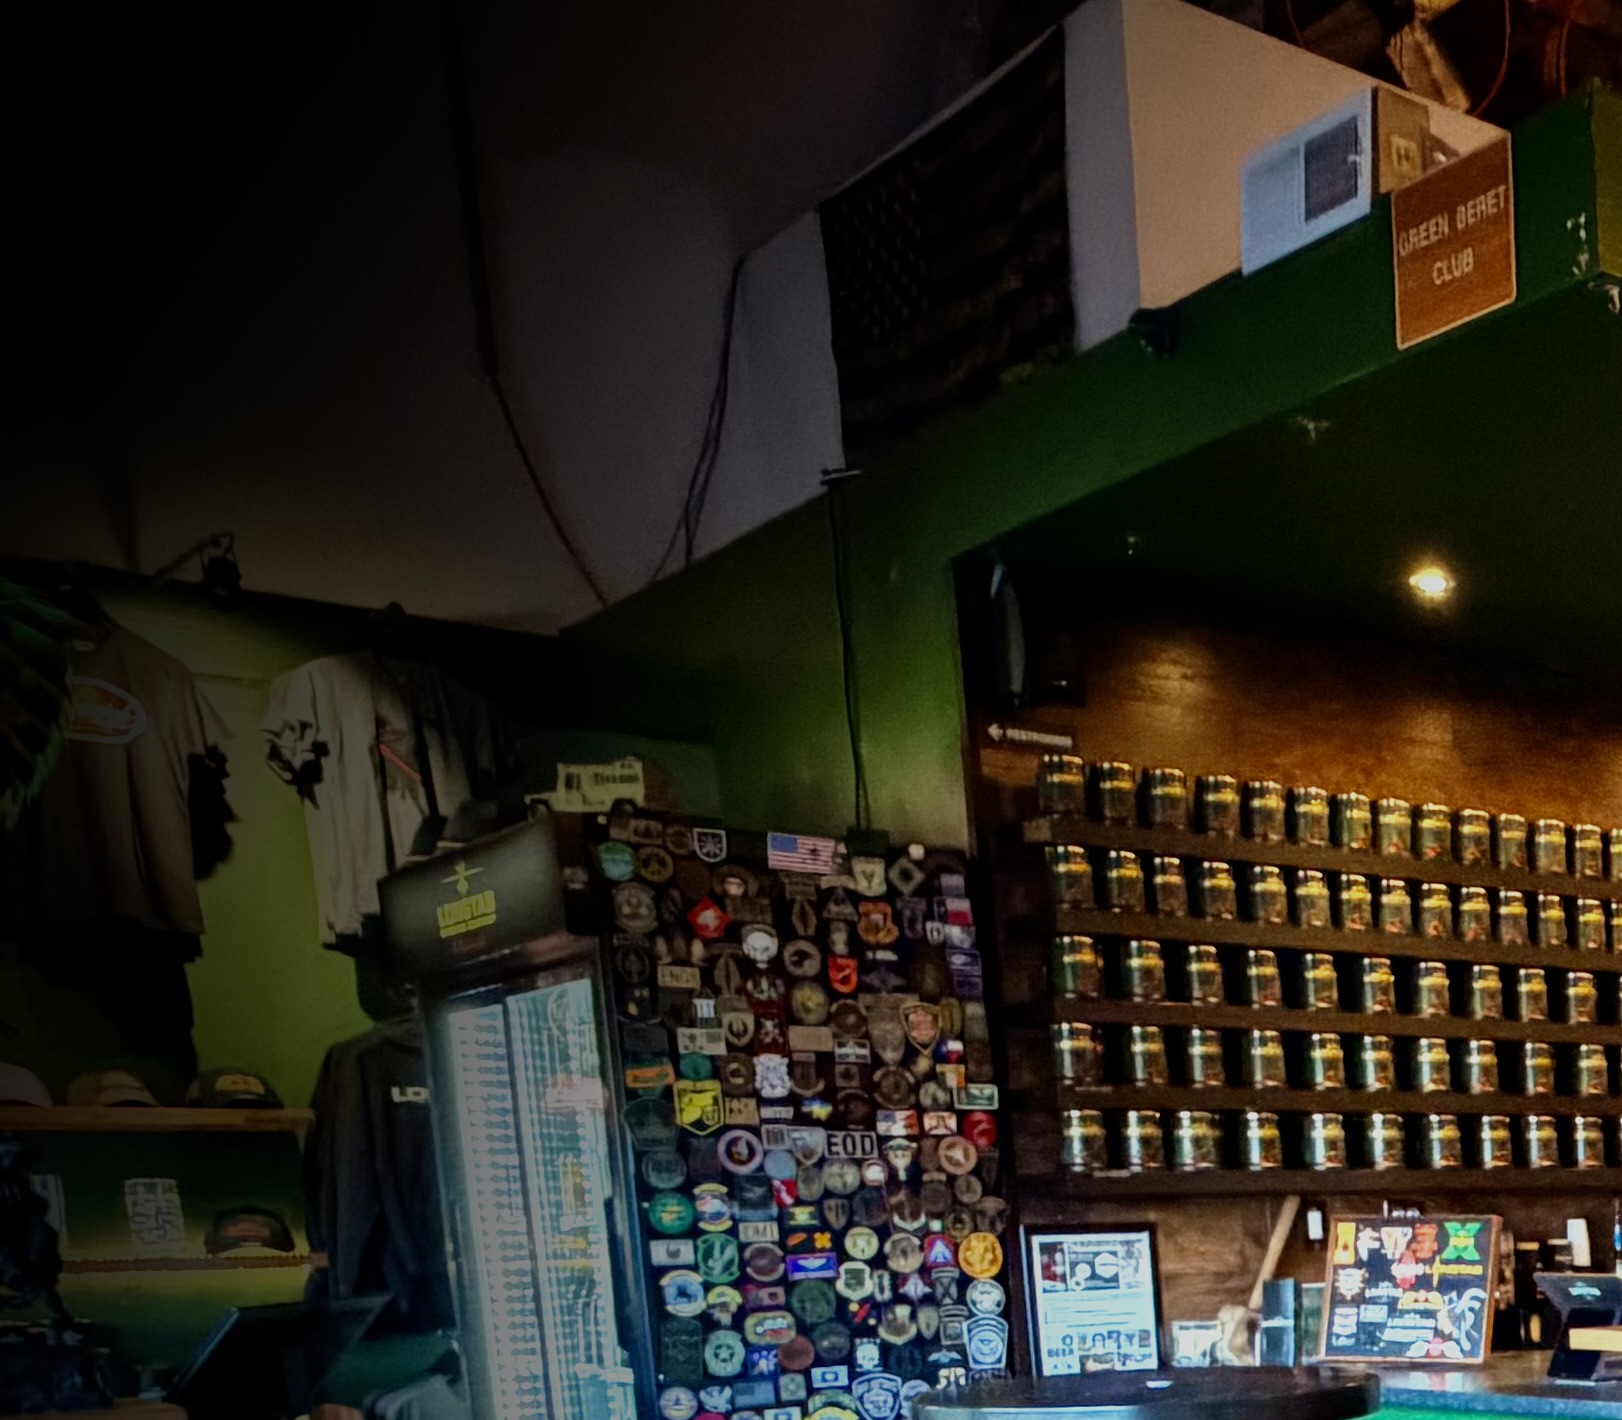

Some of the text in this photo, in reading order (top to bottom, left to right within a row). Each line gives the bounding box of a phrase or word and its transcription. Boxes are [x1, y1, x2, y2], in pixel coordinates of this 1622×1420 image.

[1399, 185, 1506, 257] GREEN BERET
[1432, 246, 1474, 286] CLUB
[827, 1134, 878, 1157] EOD
